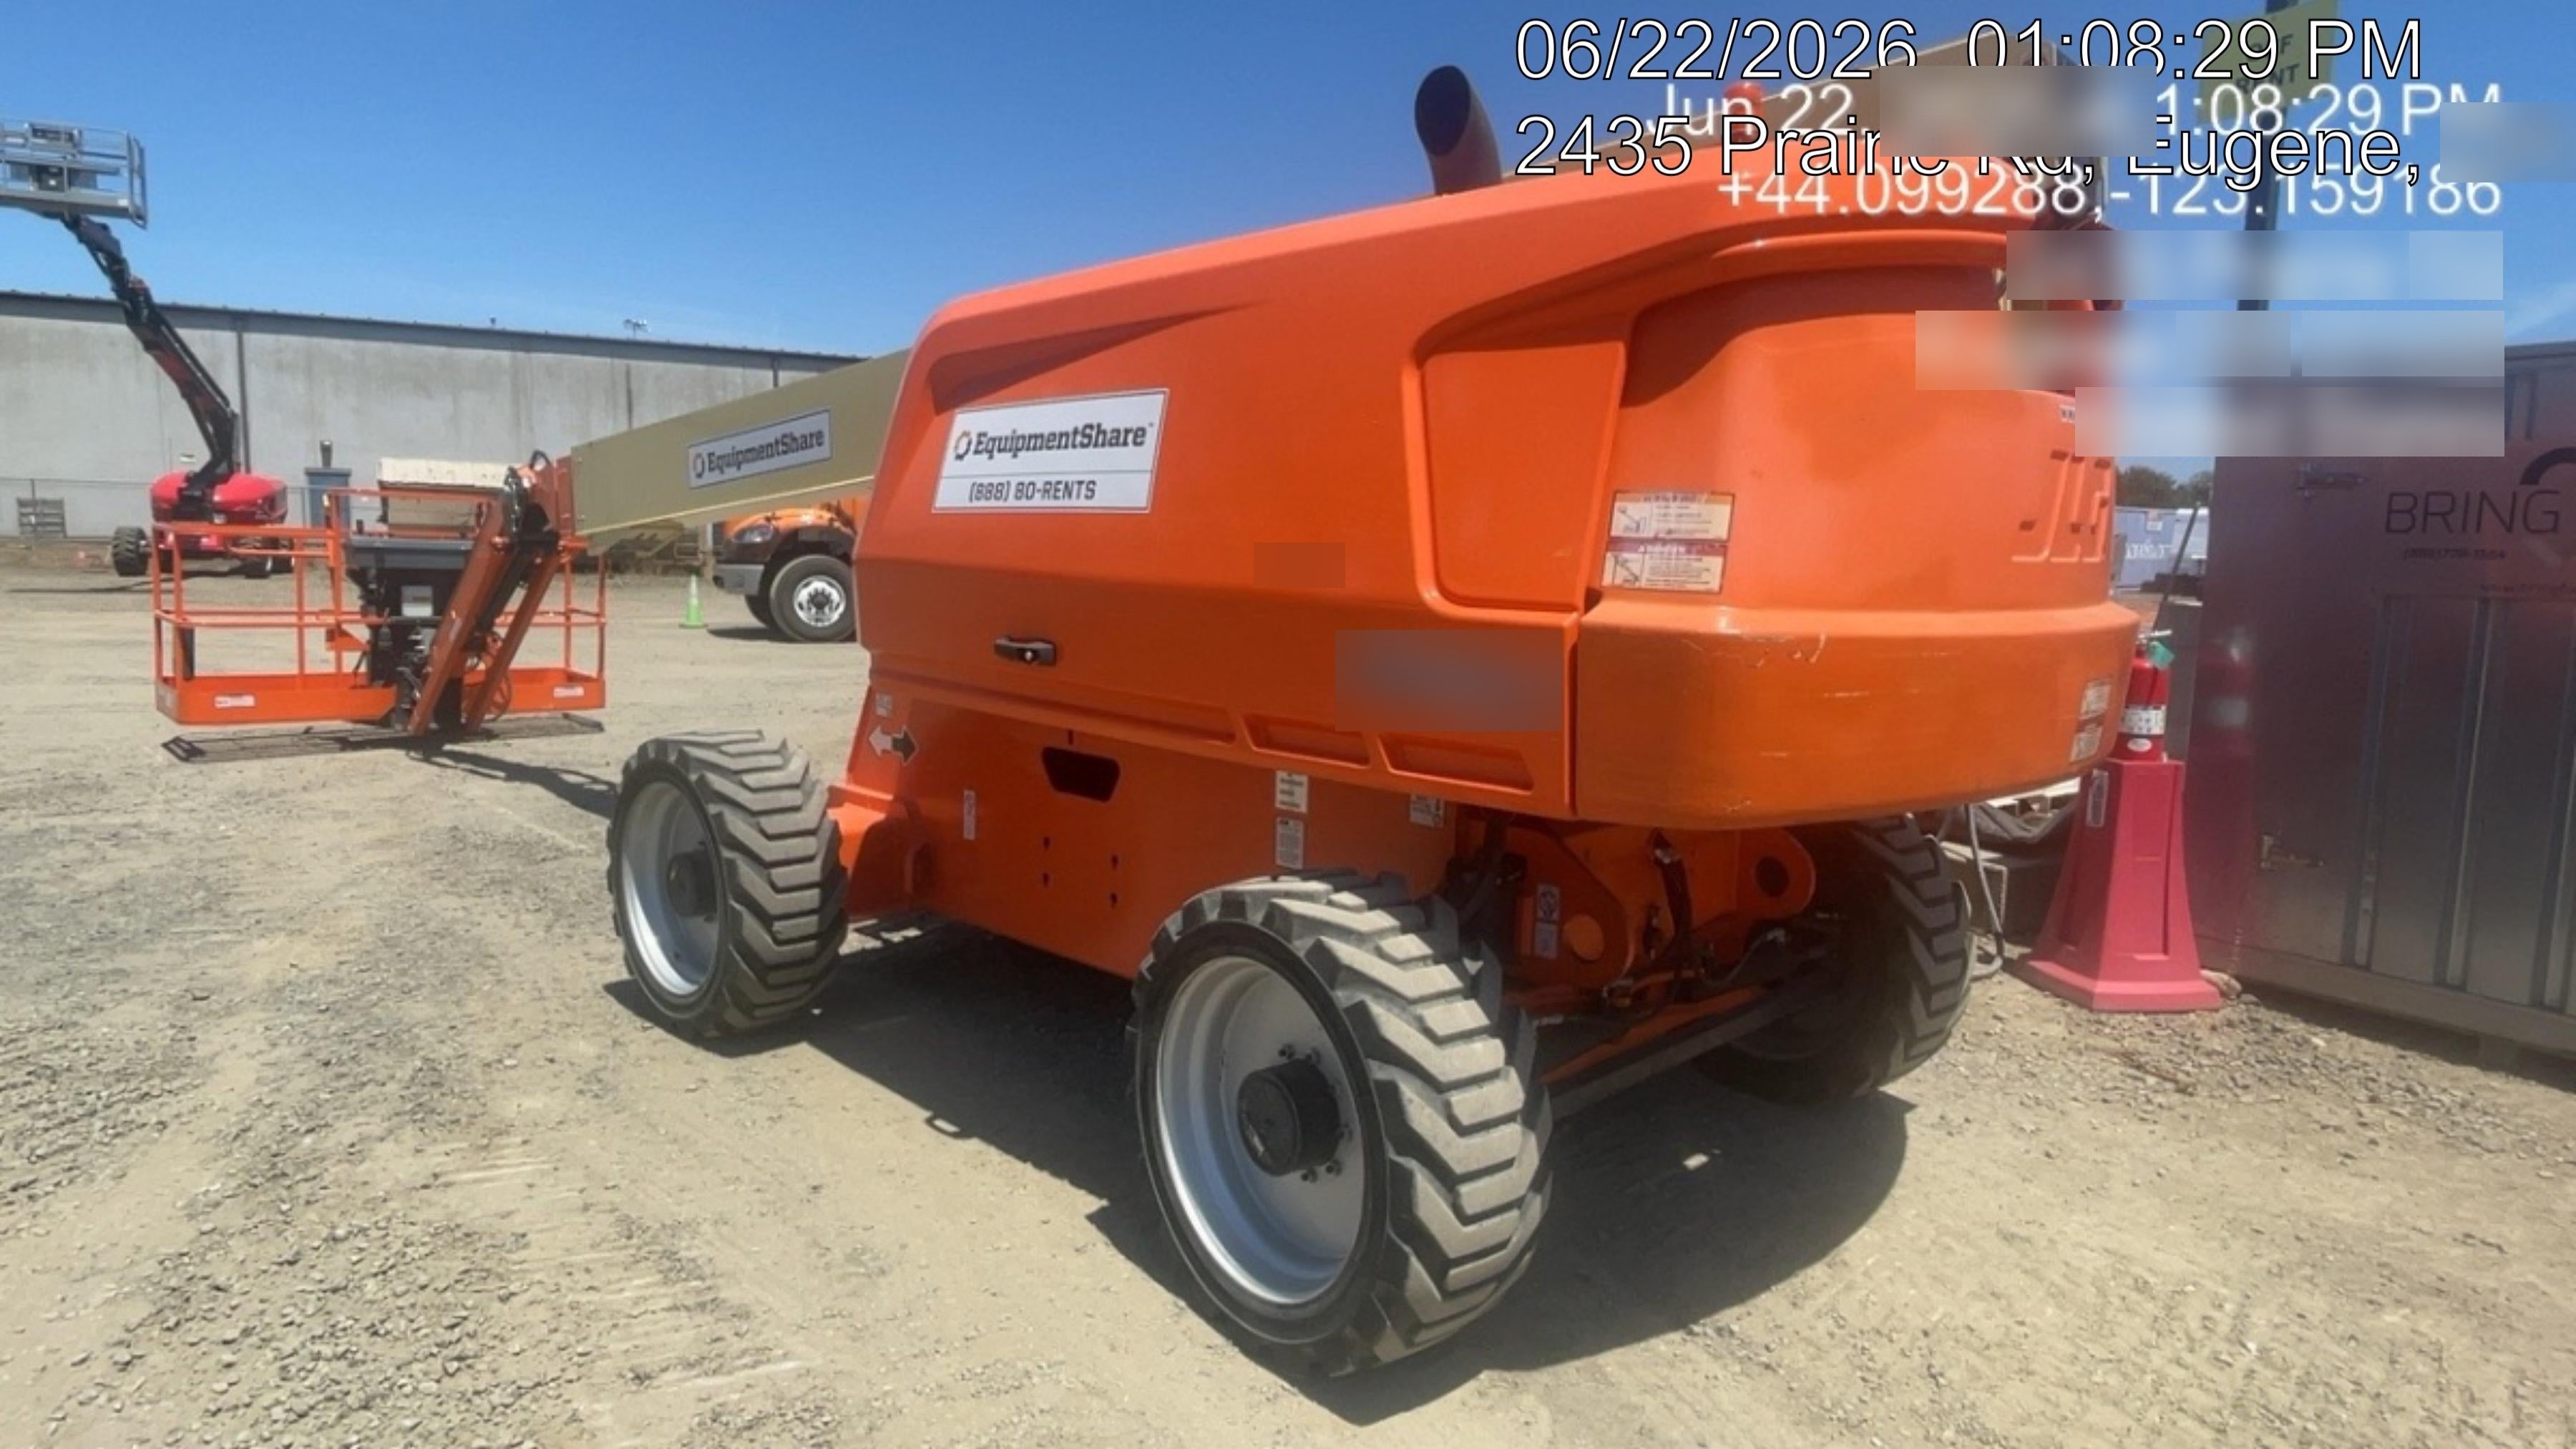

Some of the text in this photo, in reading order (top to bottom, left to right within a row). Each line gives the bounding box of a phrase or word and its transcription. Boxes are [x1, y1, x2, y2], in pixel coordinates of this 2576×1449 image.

[707, 430, 824, 474] EquipmentShare
[972, 422, 1147, 459] EquipmentShare
[969, 480, 1010, 502] (888)
[2385, 489, 2560, 535] BRING
